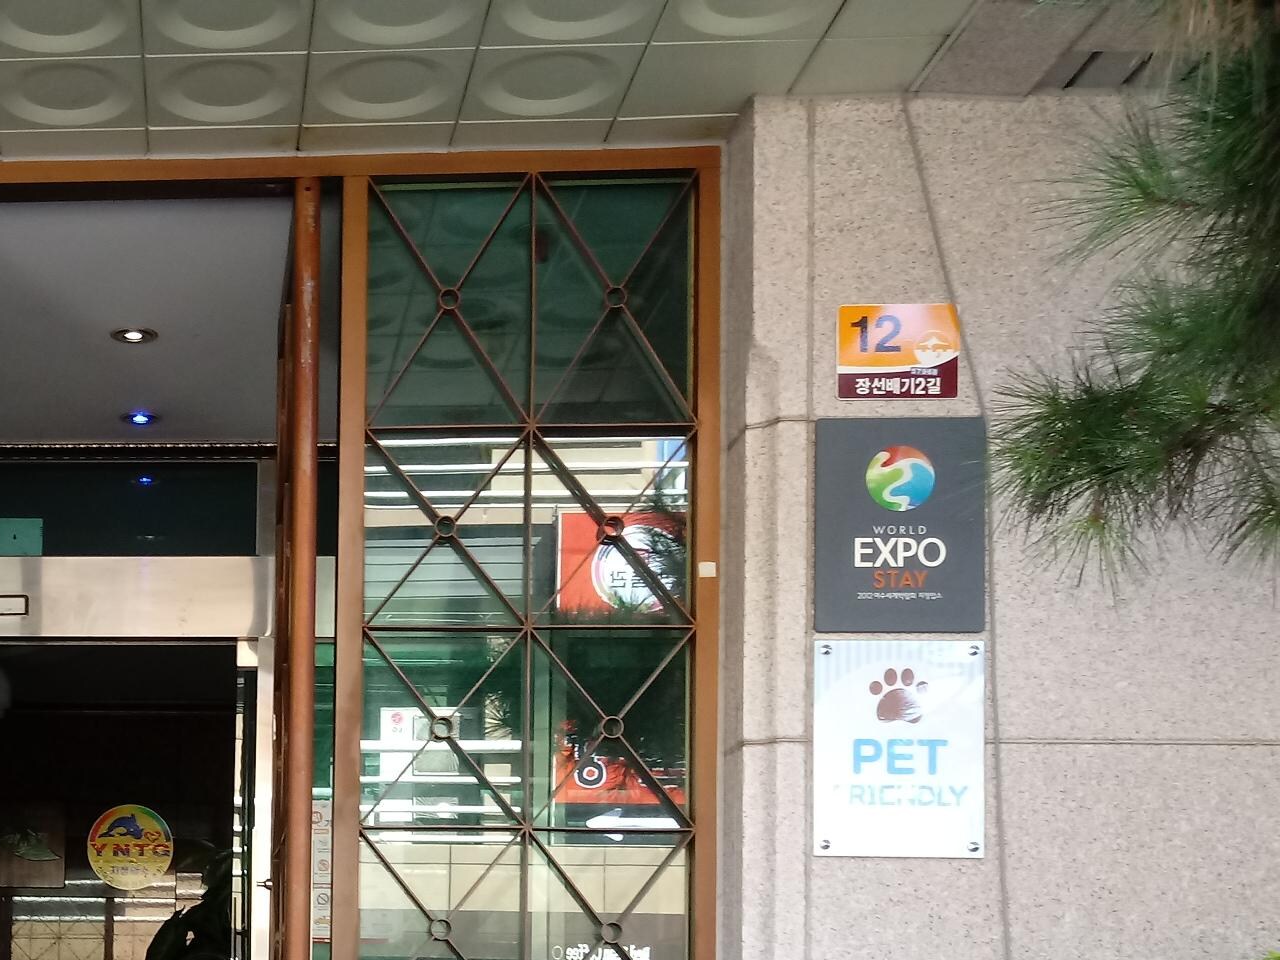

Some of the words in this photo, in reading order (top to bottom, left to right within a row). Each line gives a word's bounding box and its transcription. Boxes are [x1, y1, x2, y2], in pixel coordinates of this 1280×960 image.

[850, 314, 902, 353] 12
[854, 377, 941, 395] 장선배기2길
[872, 525, 927, 535] WORLD
[853, 537, 947, 568] EXPO
[872, 570, 928, 589] STAY
[852, 738, 949, 775] PET
[832, 784, 969, 806] RIEDLY
